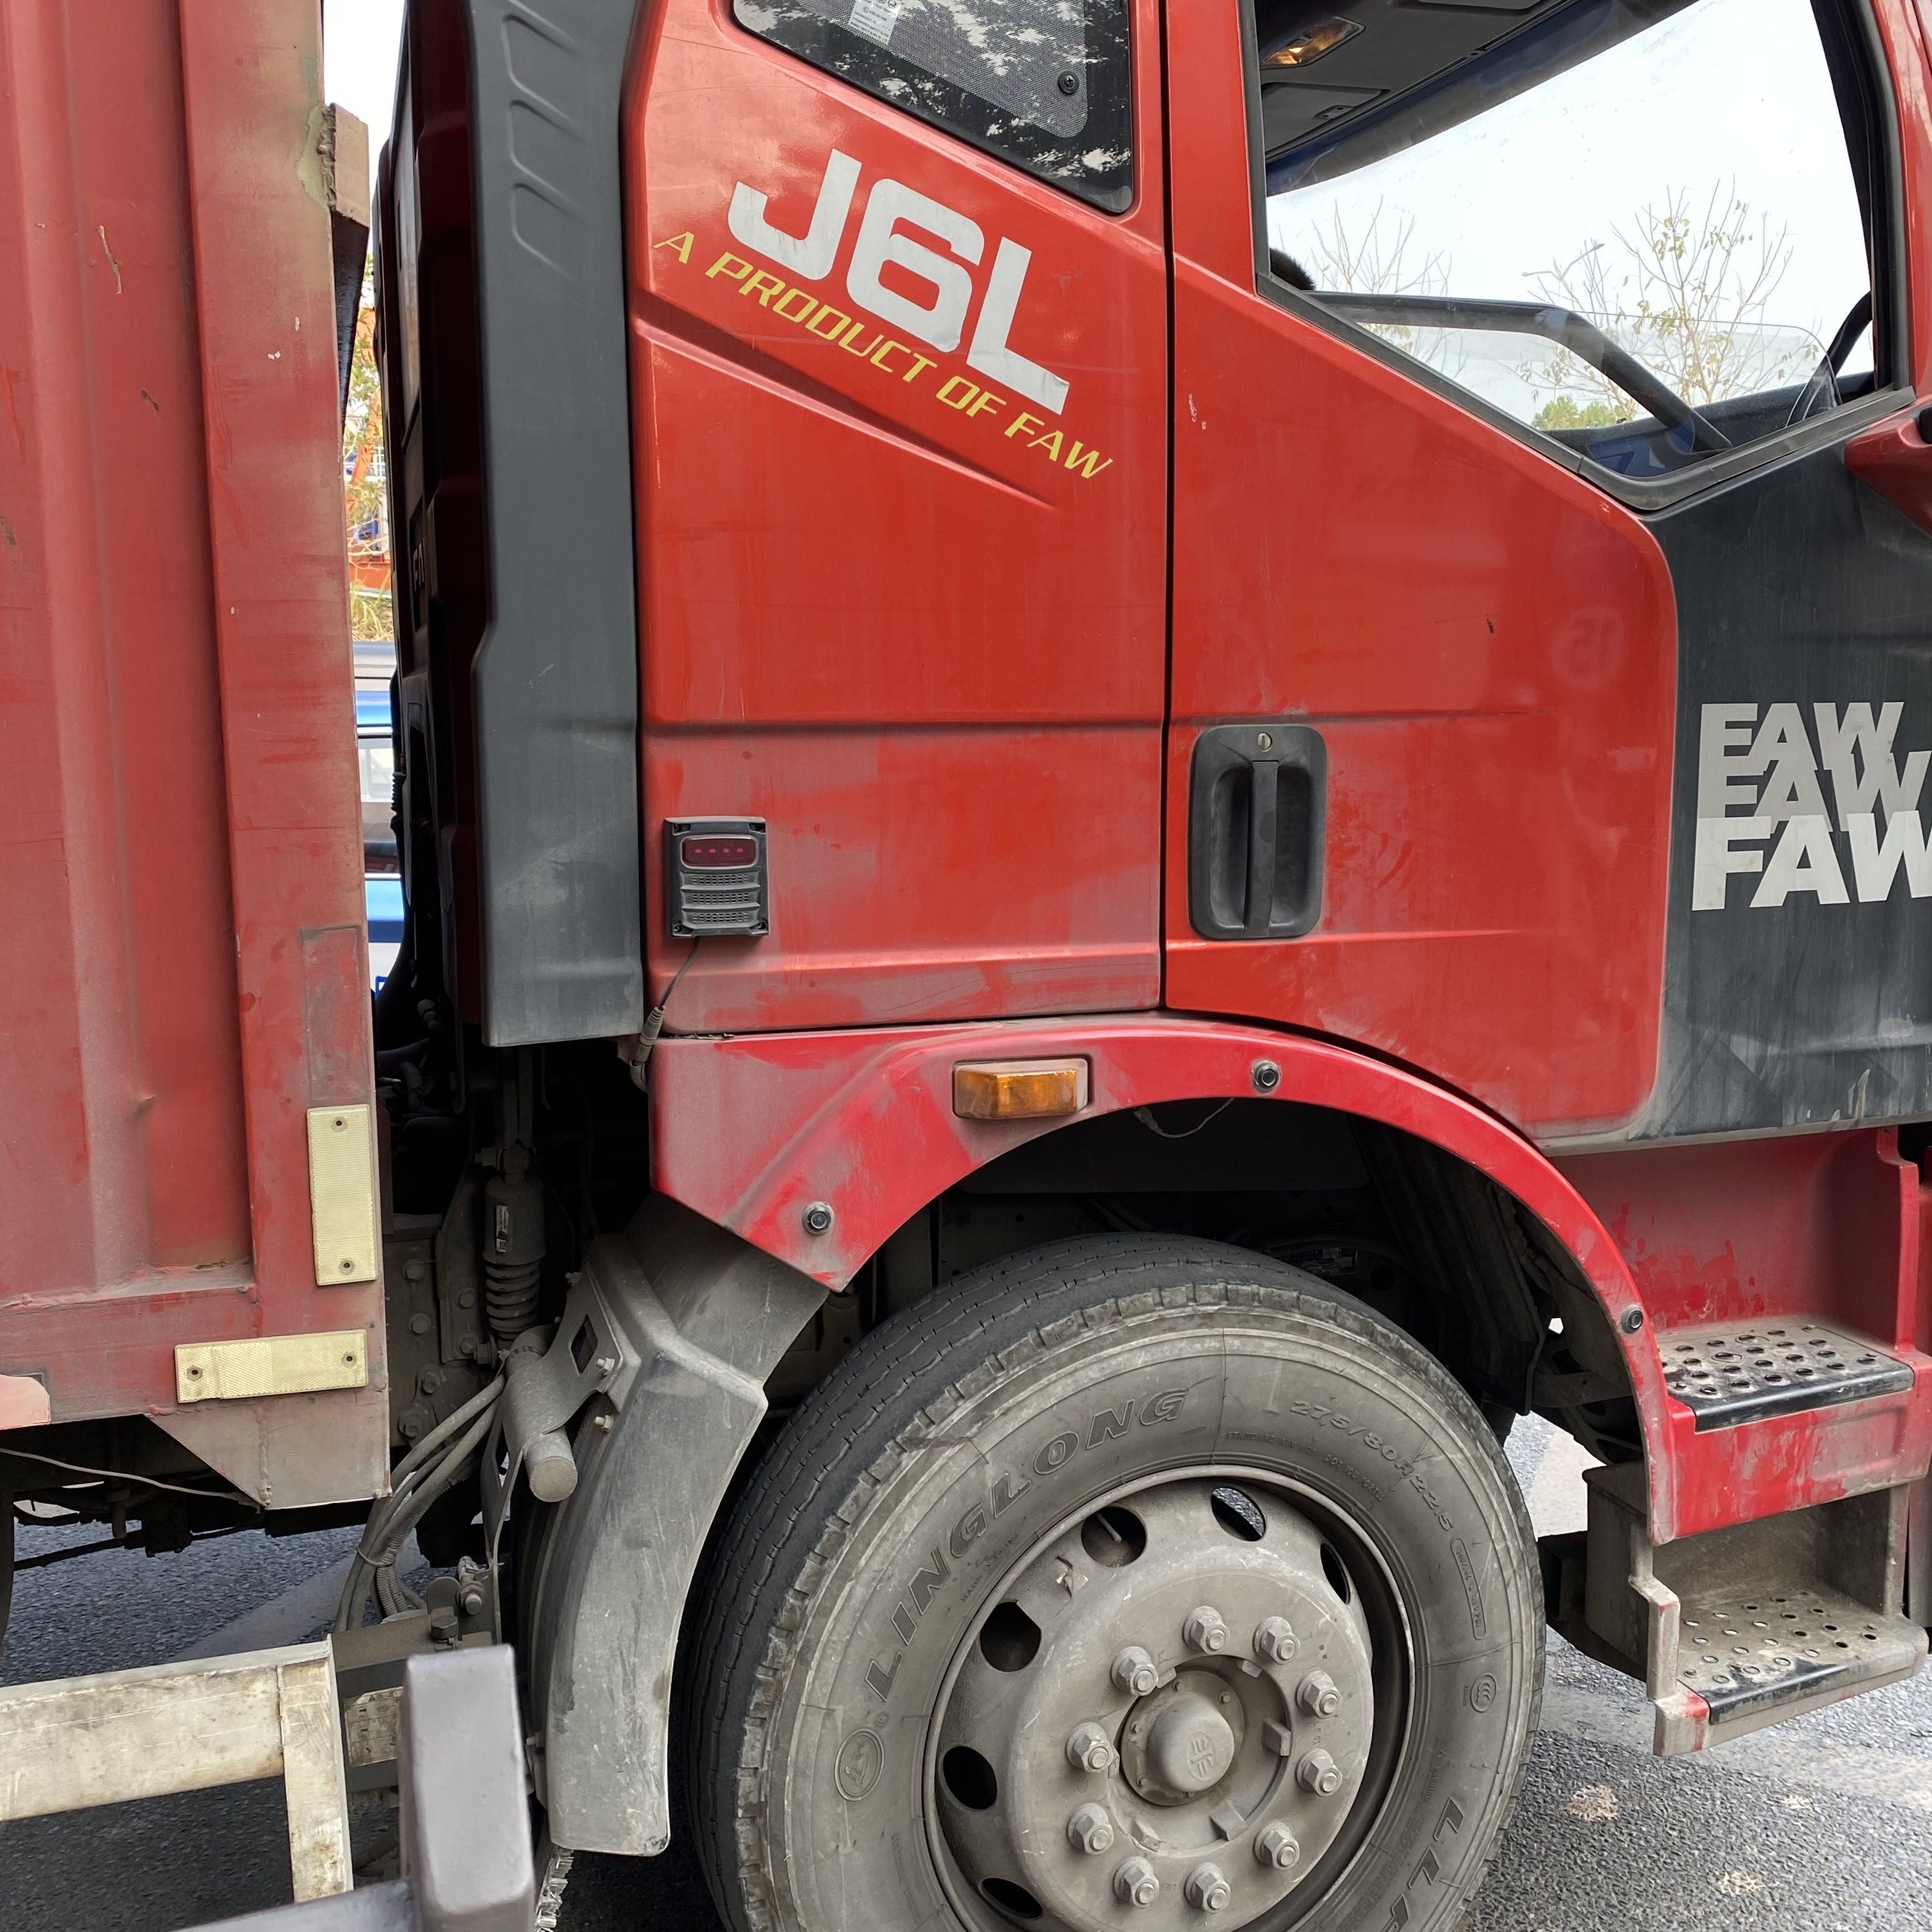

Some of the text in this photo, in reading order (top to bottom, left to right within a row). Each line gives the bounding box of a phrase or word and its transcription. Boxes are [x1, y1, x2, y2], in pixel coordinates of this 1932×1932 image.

[653, 231, 1113, 479] A PRODUCT OF FAW
[728, 148, 1070, 415] J6L
[1692, 810, 1932, 911] FAW
[864, 1388, 1189, 1702] LINGLONG
